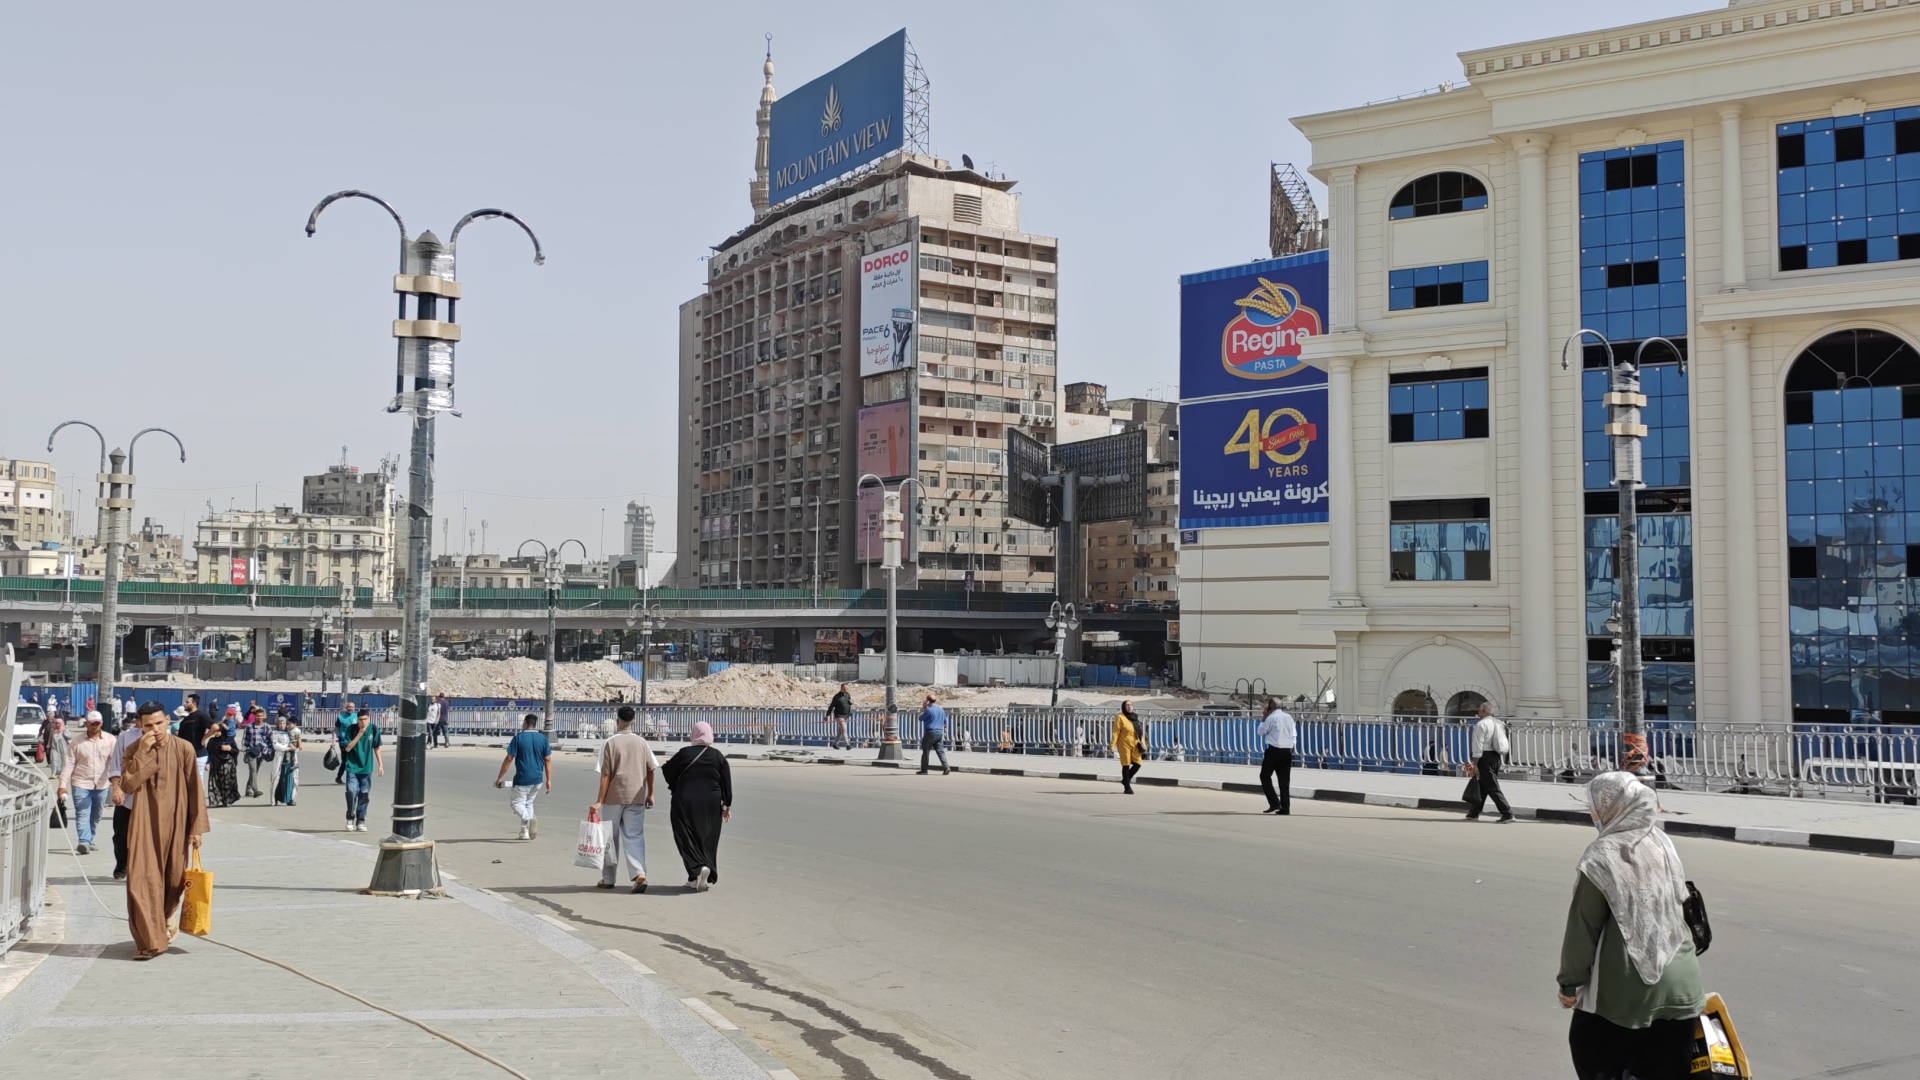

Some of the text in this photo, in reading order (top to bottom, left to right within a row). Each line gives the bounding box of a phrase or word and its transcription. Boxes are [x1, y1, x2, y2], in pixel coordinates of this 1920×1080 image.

[776, 115, 892, 192] MOUNTAIN VIEW
[864, 250, 909, 273] DORCO
[871, 281, 882, 291] العالم
[867, 343, 890, 356] تكنولوجيا
[874, 355, 889, 366] كورية
[1254, 358, 1287, 372] PASTA
[1223, 407, 1310, 470] 40
[1268, 427, 1305, 450] Since 1986
[1267, 464, 1309, 478] YEARS
[1238, 486, 1281, 508] يعني
[1284, 480, 1329, 505] كرونة
